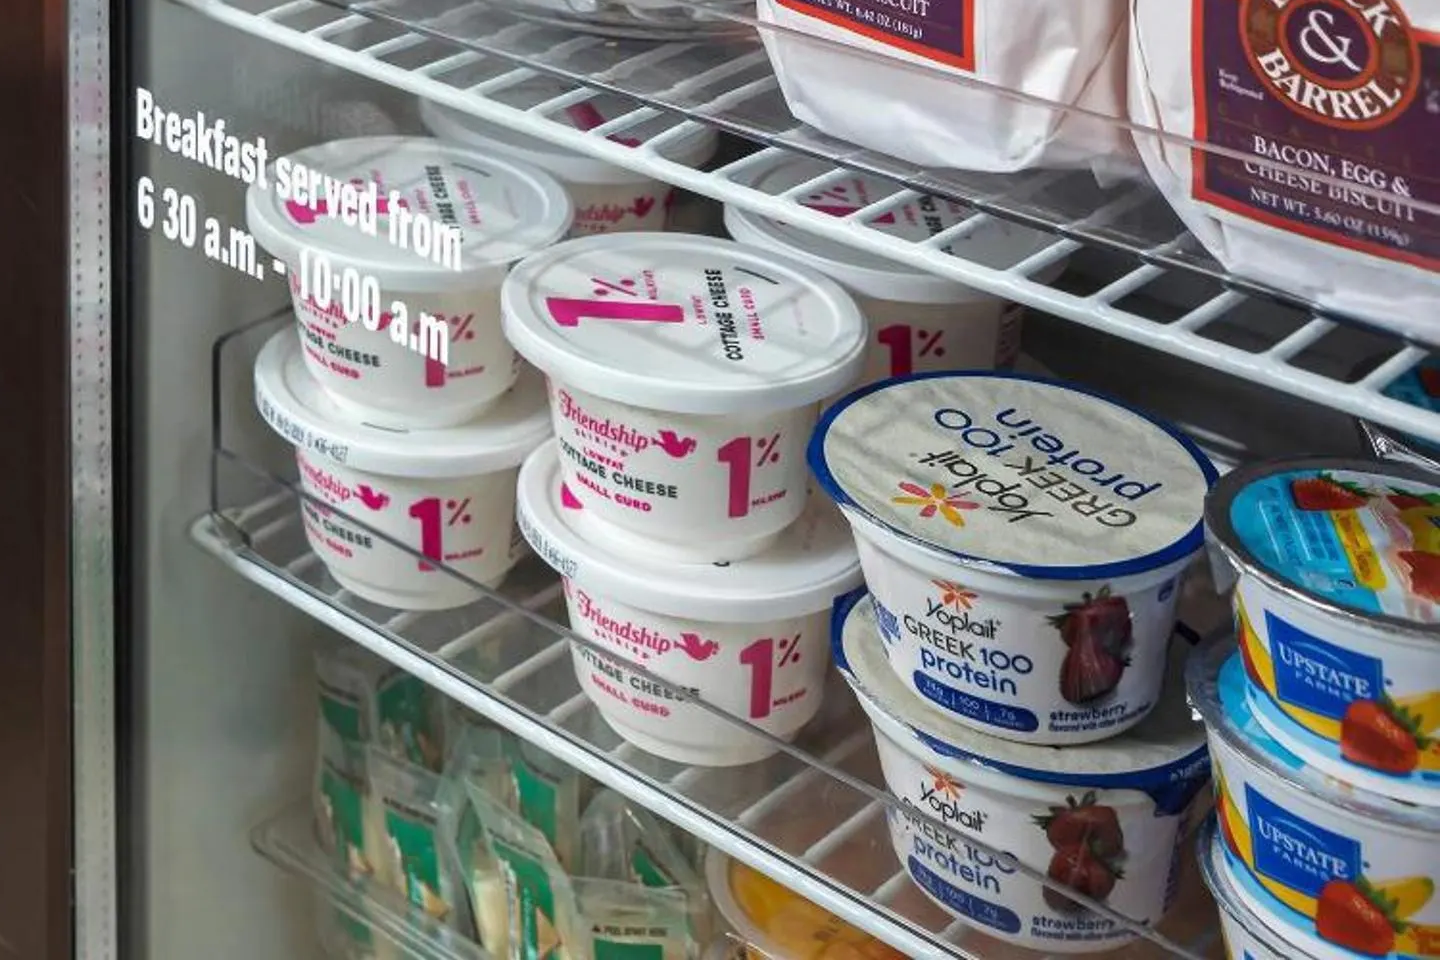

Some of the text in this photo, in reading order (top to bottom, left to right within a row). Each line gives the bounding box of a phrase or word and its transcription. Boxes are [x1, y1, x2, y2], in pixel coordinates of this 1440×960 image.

[1299, 9, 1362, 72] &
[1257, 47, 1403, 120] BARREL
[135, 86, 463, 272] Breakfast served from
[1244, 160, 1416, 222] CHEESE BISCUIT
[1253, 135, 1411, 198] BACON, EGG &
[1250, 187, 1280, 210] NET
[203, 216, 265, 281] a.m.
[704, 268, 744, 361] COTTAGE CHEESE
[327, 341, 382, 368] CHEESE
[877, 323, 946, 377] 1%
[559, 390, 649, 453] Friendship
[611, 465, 679, 500] CHEESE
[717, 432, 781, 519] 1%
[934, 407, 1138, 528] GREEK 100
[996, 407, 1163, 501] protein
[614, 493, 653, 514] CURD
[917, 450, 1055, 524] Yoplait
[408, 497, 473, 572] 1%
[577, 589, 671, 656] Friendship
[902, 614, 977, 662] GREEK
[979, 646, 1034, 675] 100
[926, 596, 998, 641] Yoplait
[739, 632, 802, 720] 1%
[920, 646, 1018, 697] protein
[1277, 641, 1372, 699] UPSTATE
[1294, 669, 1354, 703] FARMS
[632, 698, 671, 718] CURD
[1049, 702, 1129, 723] strawberry
[919, 780, 985, 835] Yoplait
[912, 835, 1002, 896] protein
[1256, 815, 1350, 879] UPSTATE
